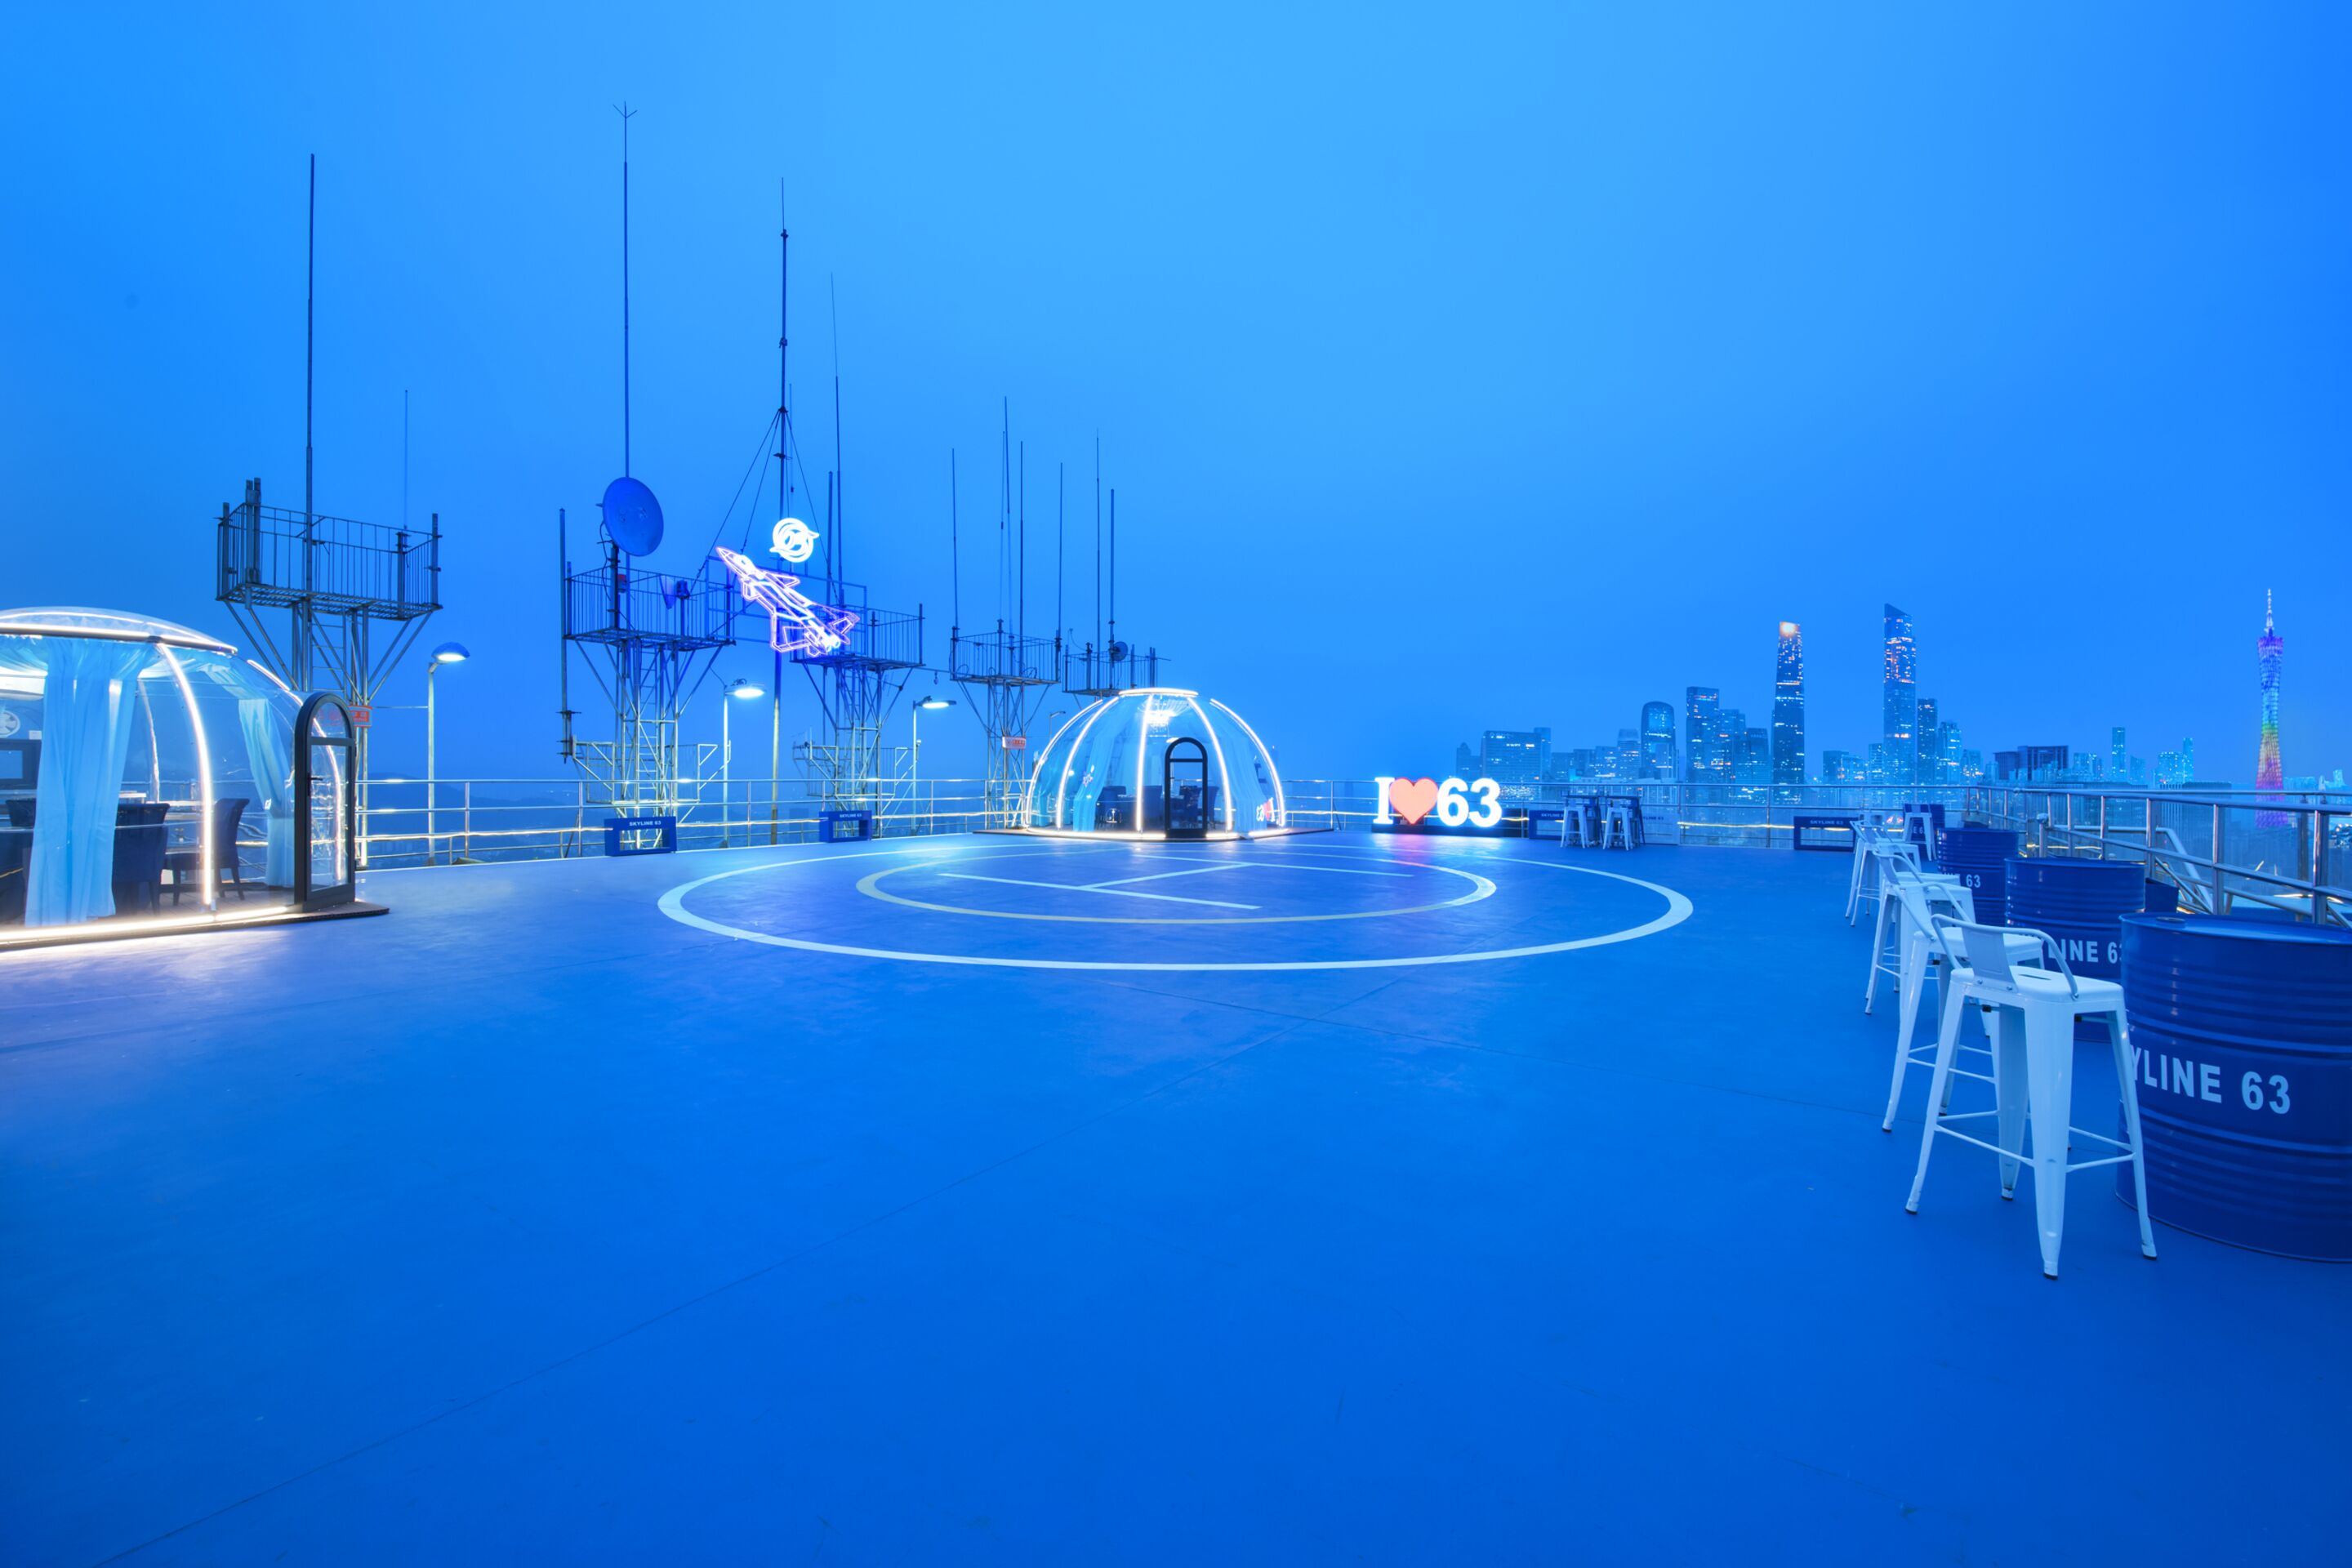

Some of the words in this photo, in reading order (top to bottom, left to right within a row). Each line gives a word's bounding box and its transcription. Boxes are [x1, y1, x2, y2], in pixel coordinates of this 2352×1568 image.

[1374, 777, 1395, 824] I
[1437, 777, 1503, 827] 63
[1966, 874, 1981, 888] 63
[2107, 942, 2122, 964] 6
[2241, 1071, 2291, 1115] 63
